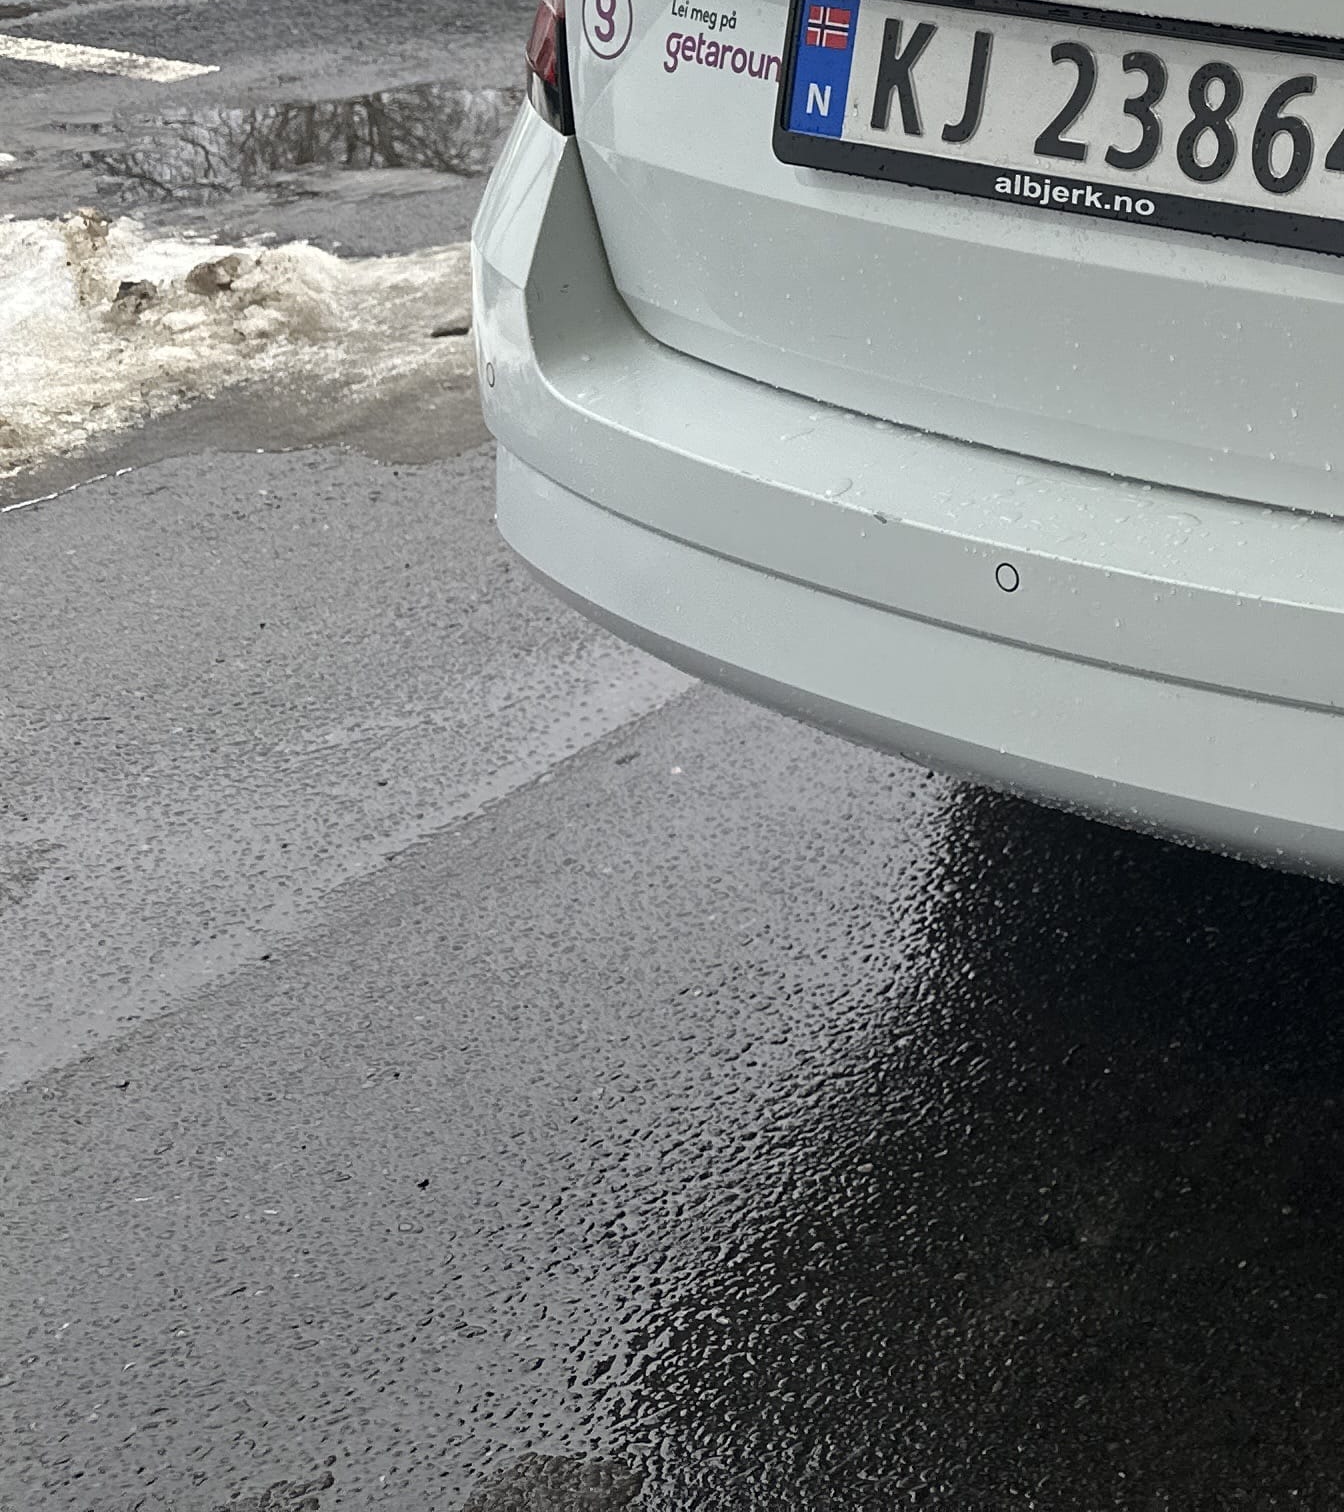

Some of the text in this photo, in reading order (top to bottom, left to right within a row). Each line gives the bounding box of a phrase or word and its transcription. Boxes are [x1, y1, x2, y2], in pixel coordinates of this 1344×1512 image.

[690, 5, 718, 30] meg
[719, 11, 737, 32] på
[663, 31, 782, 83] getaroun
[806, 83, 830, 116] N
[870, 18, 993, 143] KJ
[994, 174, 1155, 216] albjerk.no
